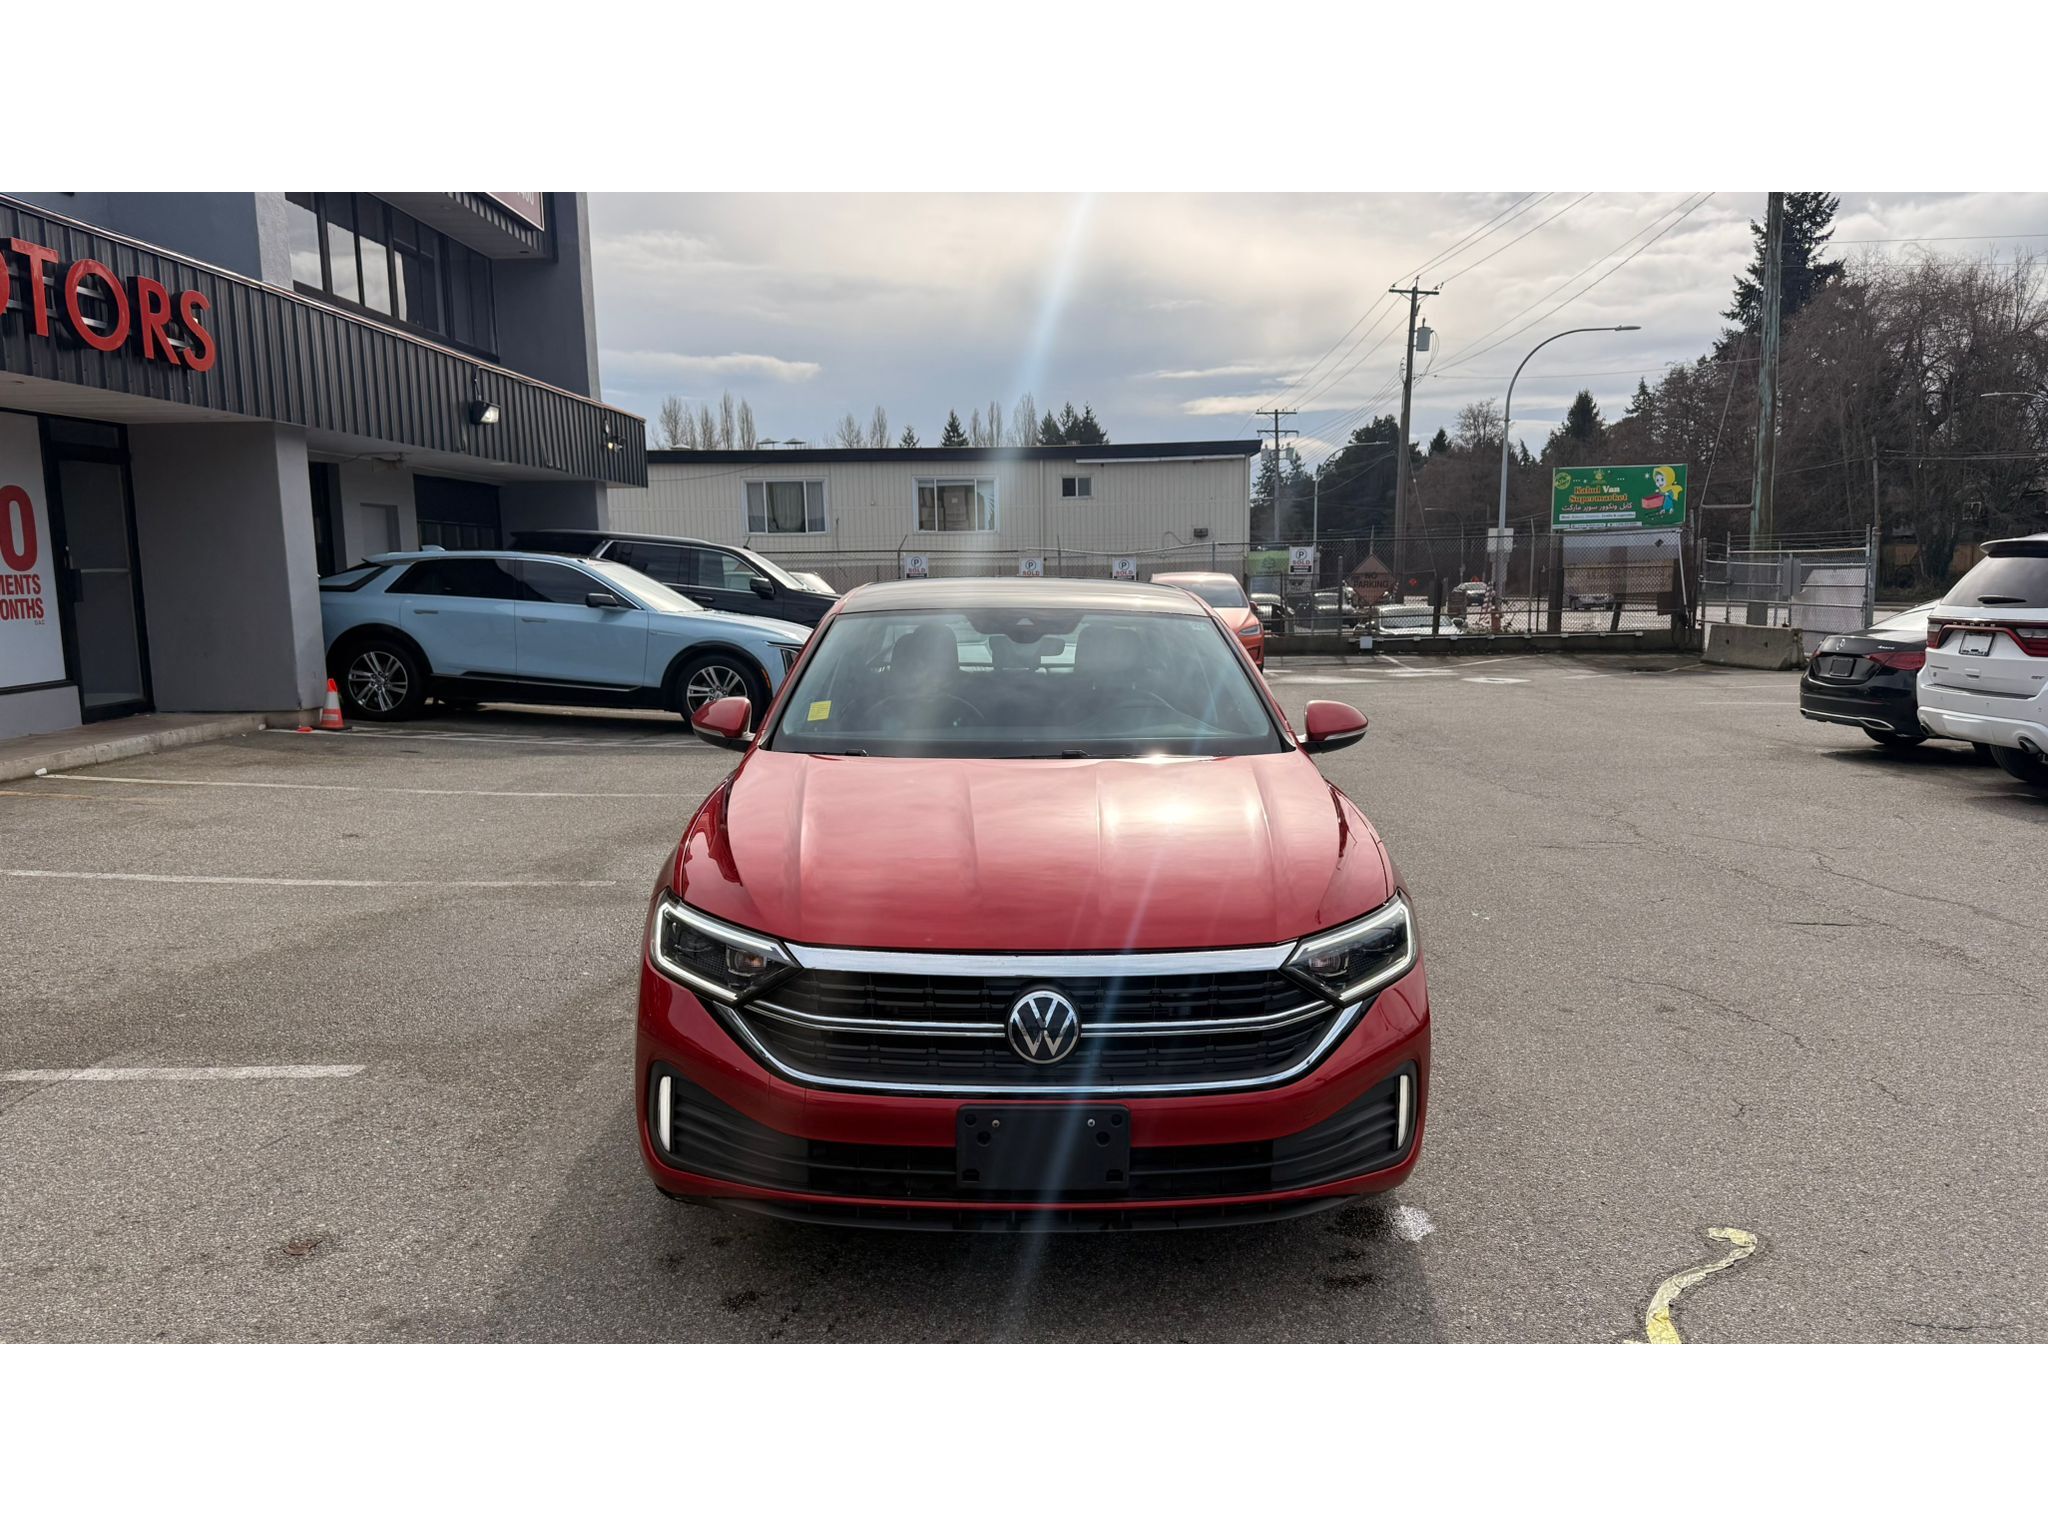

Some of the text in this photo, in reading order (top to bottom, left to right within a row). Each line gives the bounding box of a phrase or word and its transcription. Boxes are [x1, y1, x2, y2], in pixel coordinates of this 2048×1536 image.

[0, 237, 216, 373] TORS
[1602, 485, 1620, 493] Van
[1569, 493, 1628, 504] Supermarket
[1354, 580, 1389, 588] PARKING
[1010, 993, 1076, 1061] VW
